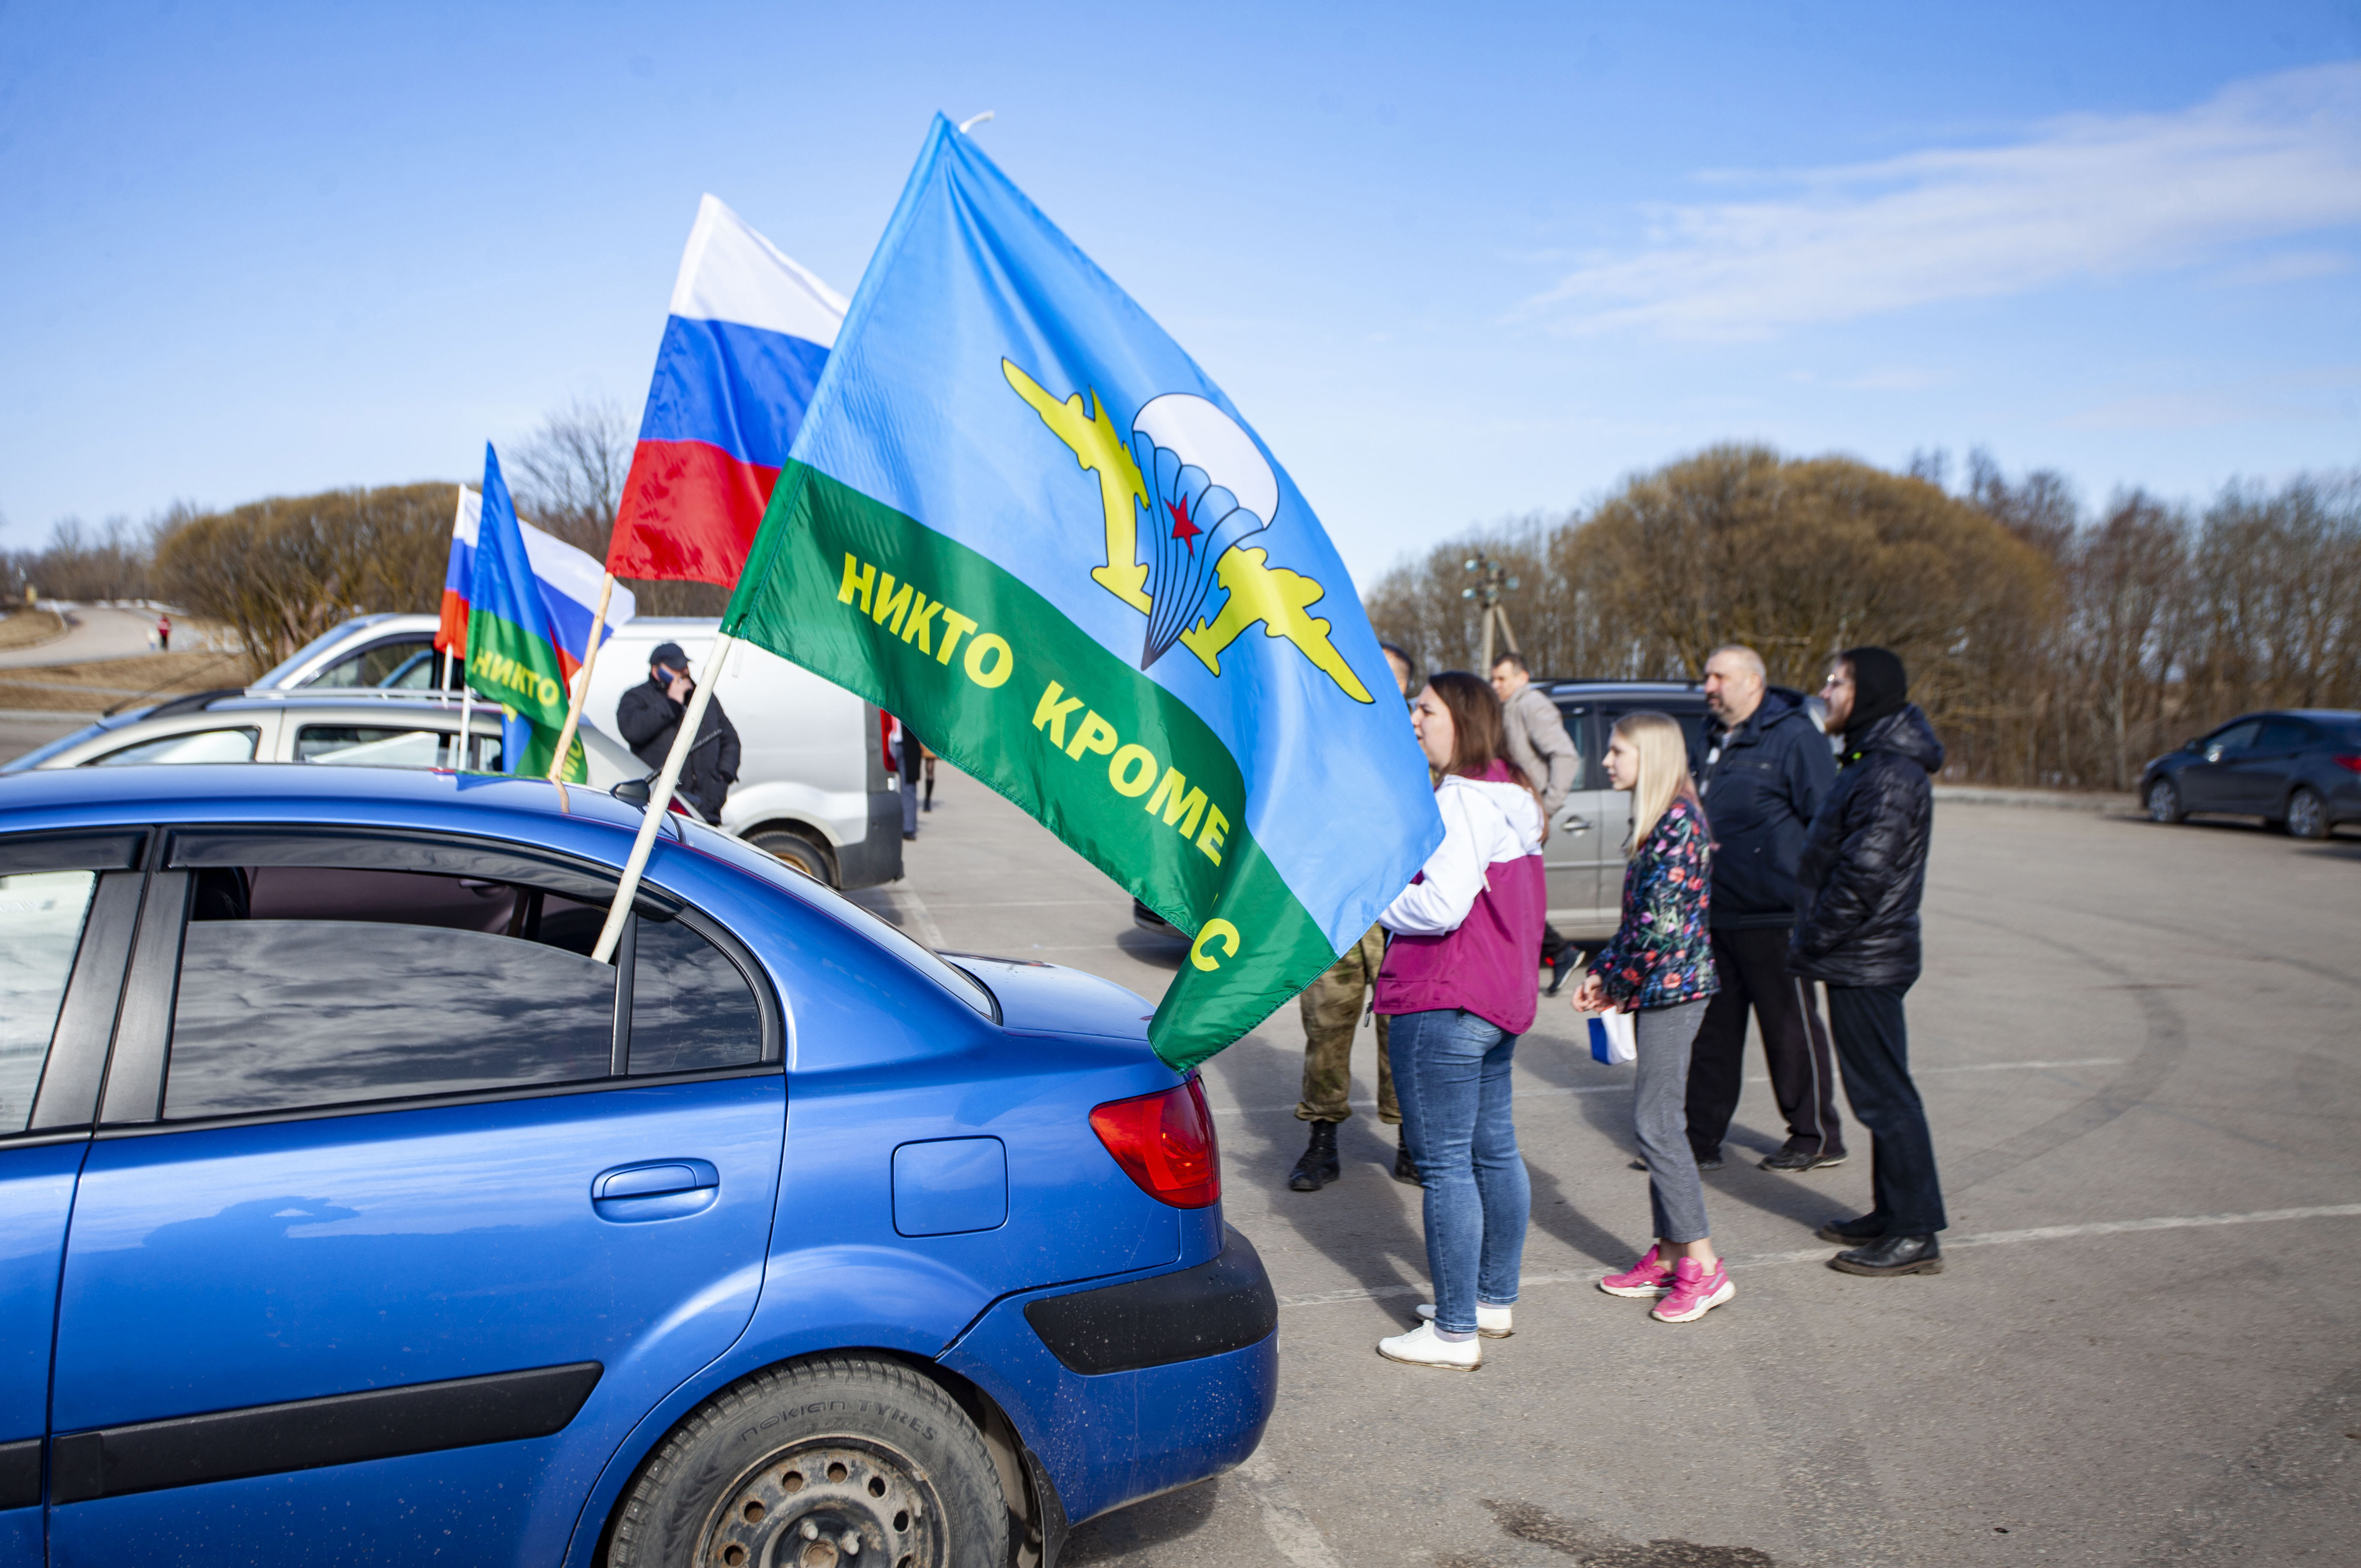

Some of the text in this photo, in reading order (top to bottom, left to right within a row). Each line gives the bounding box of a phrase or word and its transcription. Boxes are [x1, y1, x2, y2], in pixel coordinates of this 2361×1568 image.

[472, 648, 560, 707] НИКТО
[837, 552, 1014, 688] НИКТО
[1032, 680, 1229, 866] КРОМЕ
[858, 1399, 937, 1440] TYRES
